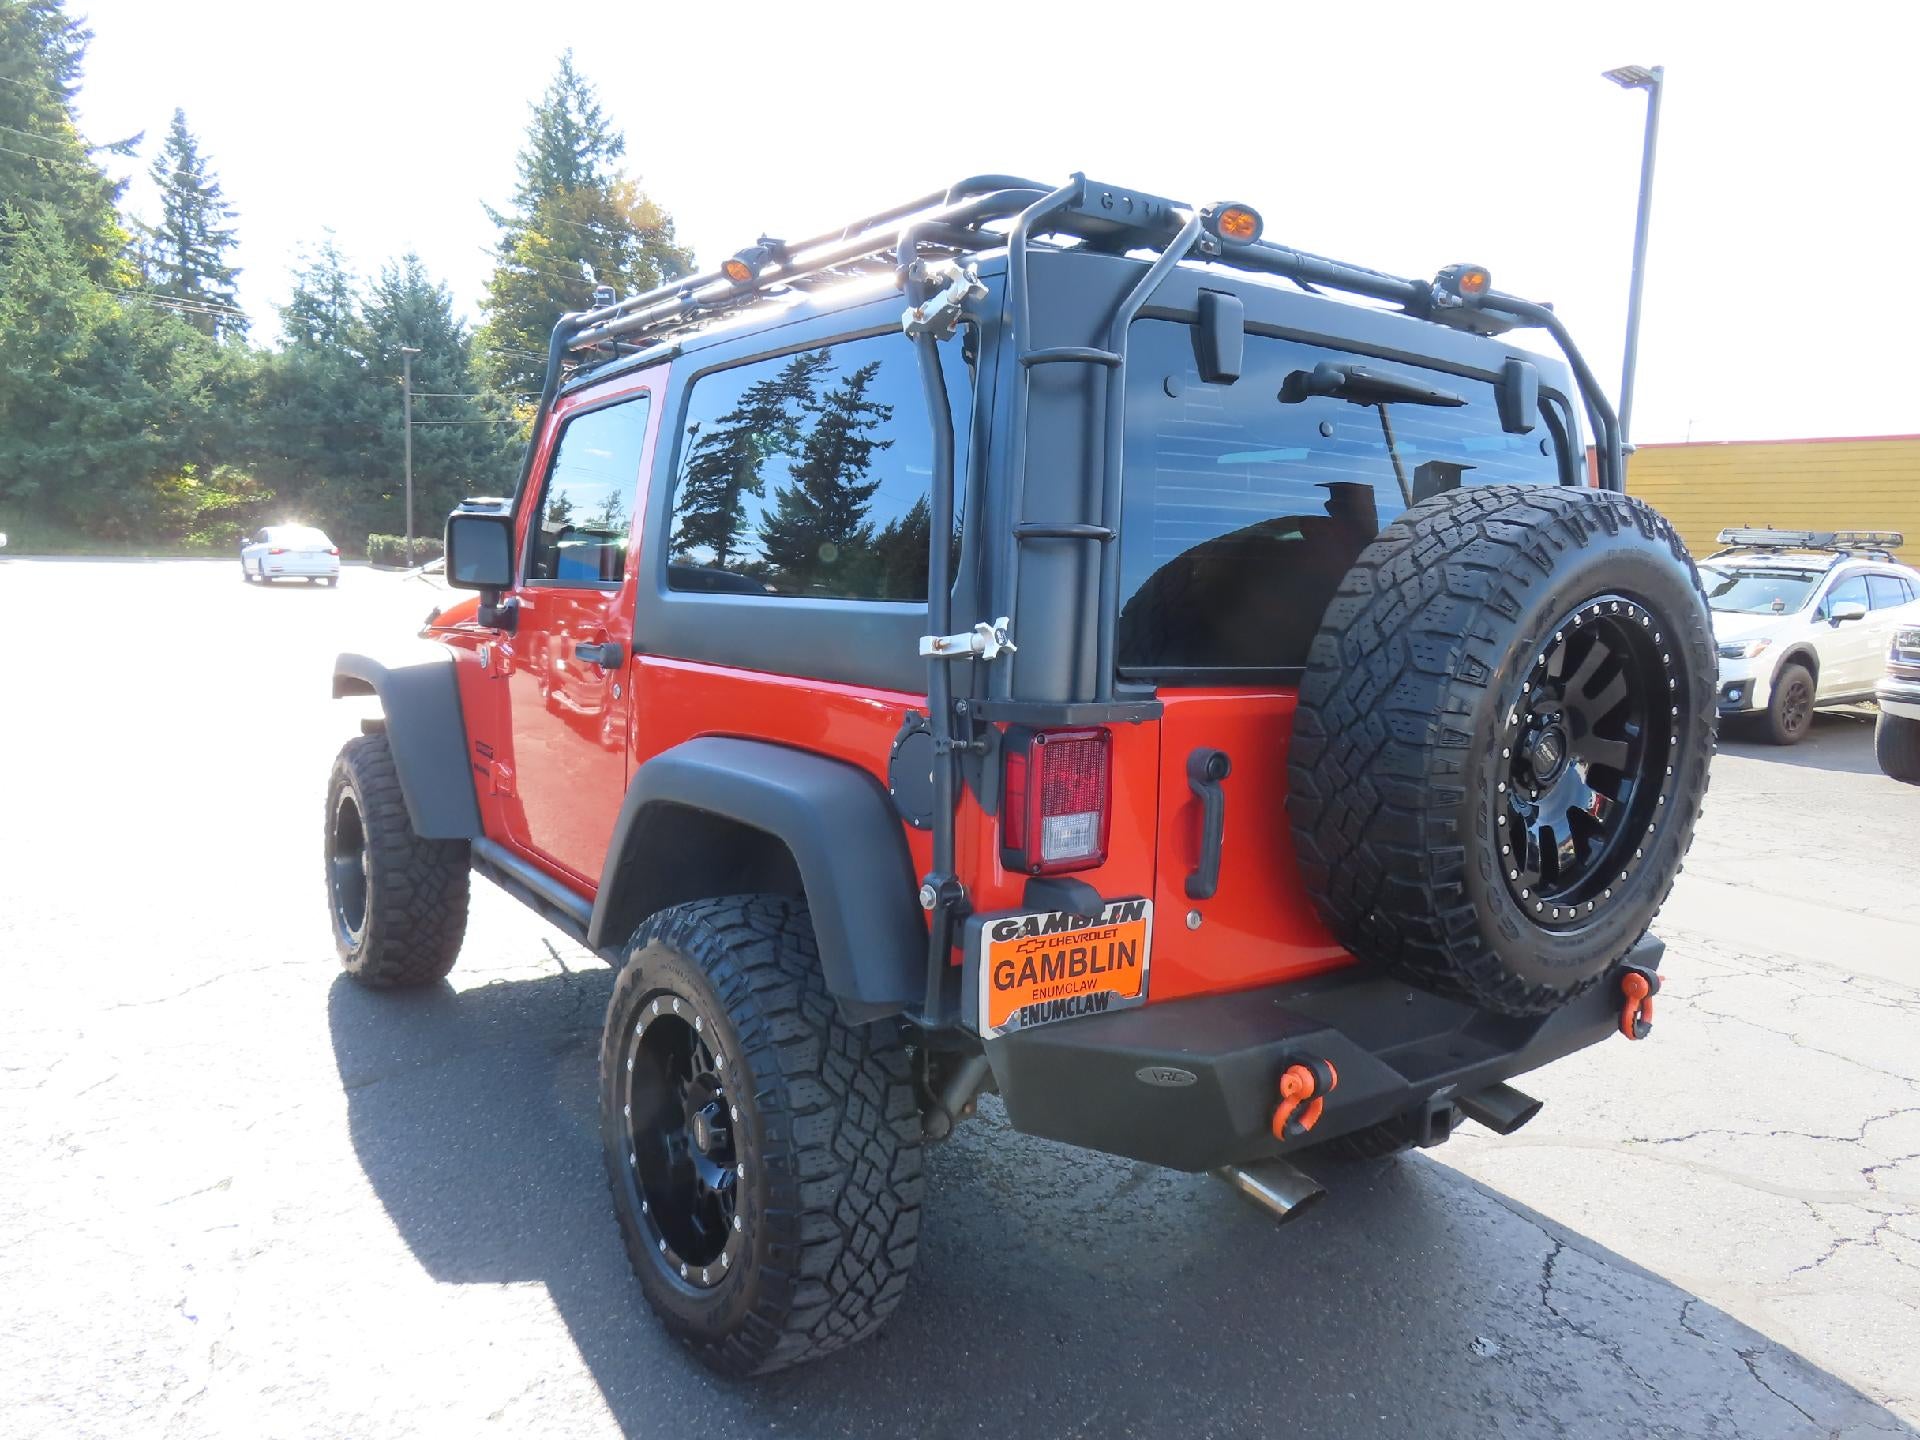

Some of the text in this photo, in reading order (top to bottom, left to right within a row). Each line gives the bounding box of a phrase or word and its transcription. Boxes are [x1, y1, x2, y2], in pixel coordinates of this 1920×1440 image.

[992, 901, 1147, 942] GAMBLIN
[1049, 928, 1118, 947] CHEVROLET
[994, 939, 1137, 991] GAMBLIN
[1032, 978, 1098, 1000] ENUMCLAW
[1020, 991, 1111, 1027] ENUMCLAW
